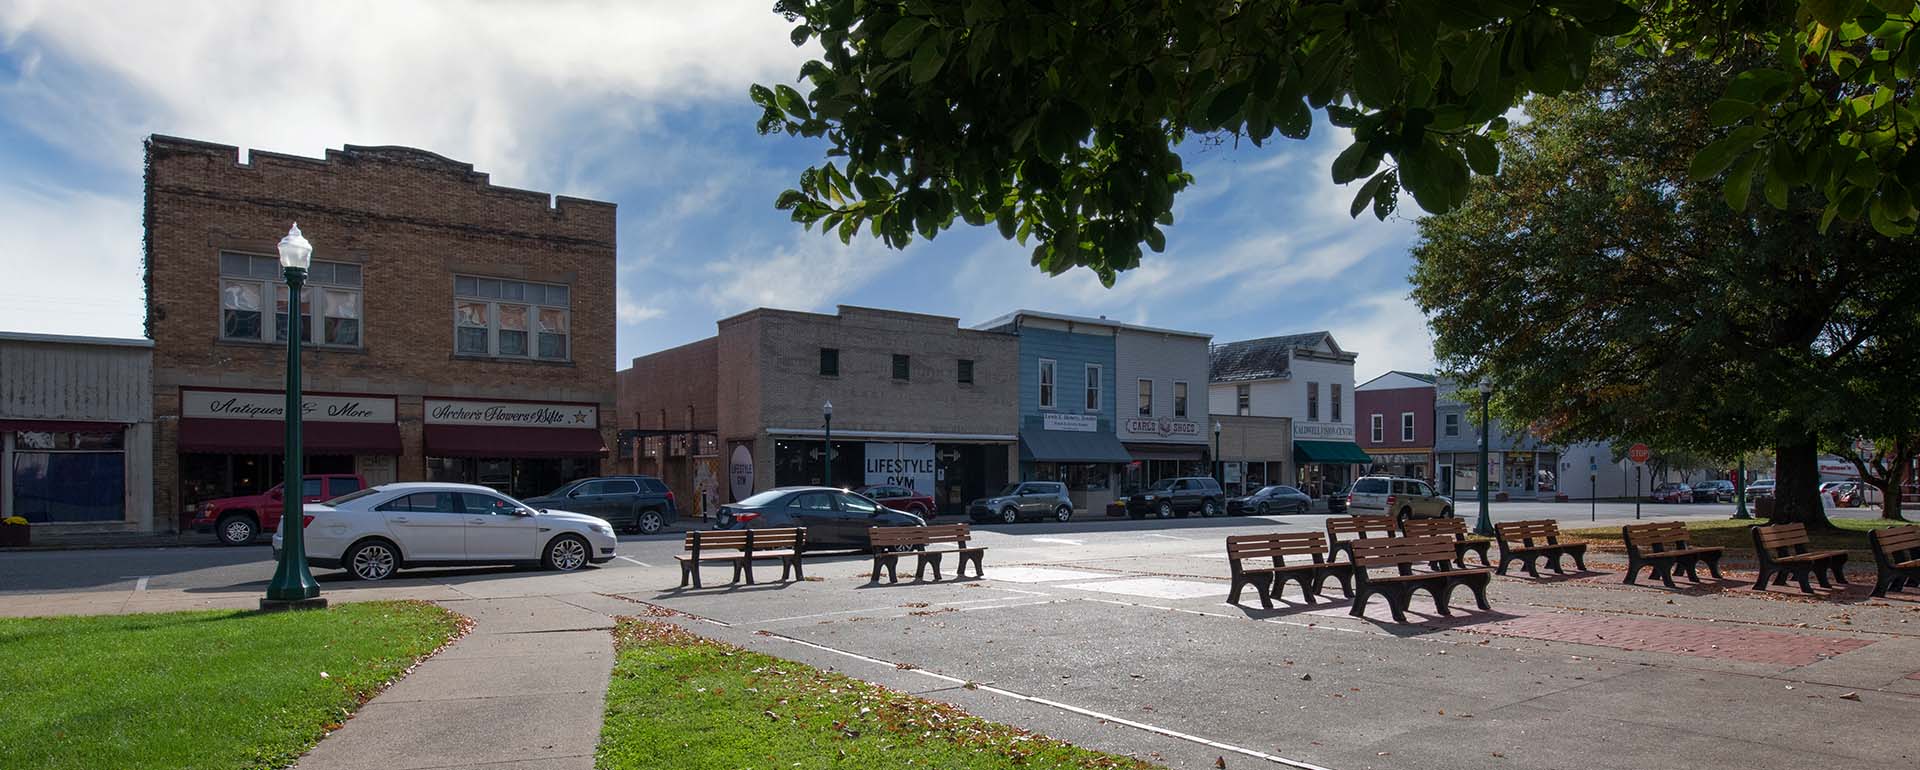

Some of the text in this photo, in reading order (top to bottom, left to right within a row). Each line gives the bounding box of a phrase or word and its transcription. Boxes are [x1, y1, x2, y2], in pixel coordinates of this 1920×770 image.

[210, 398, 283, 418] Antiques
[328, 402, 373, 417] More
[484, 405, 530, 421] Flowers
[1174, 423, 1195, 432] SHOES
[1631, 449, 1648, 457] STOP
[867, 458, 933, 473] LIFESTYLE
[887, 476, 914, 490] GYM
